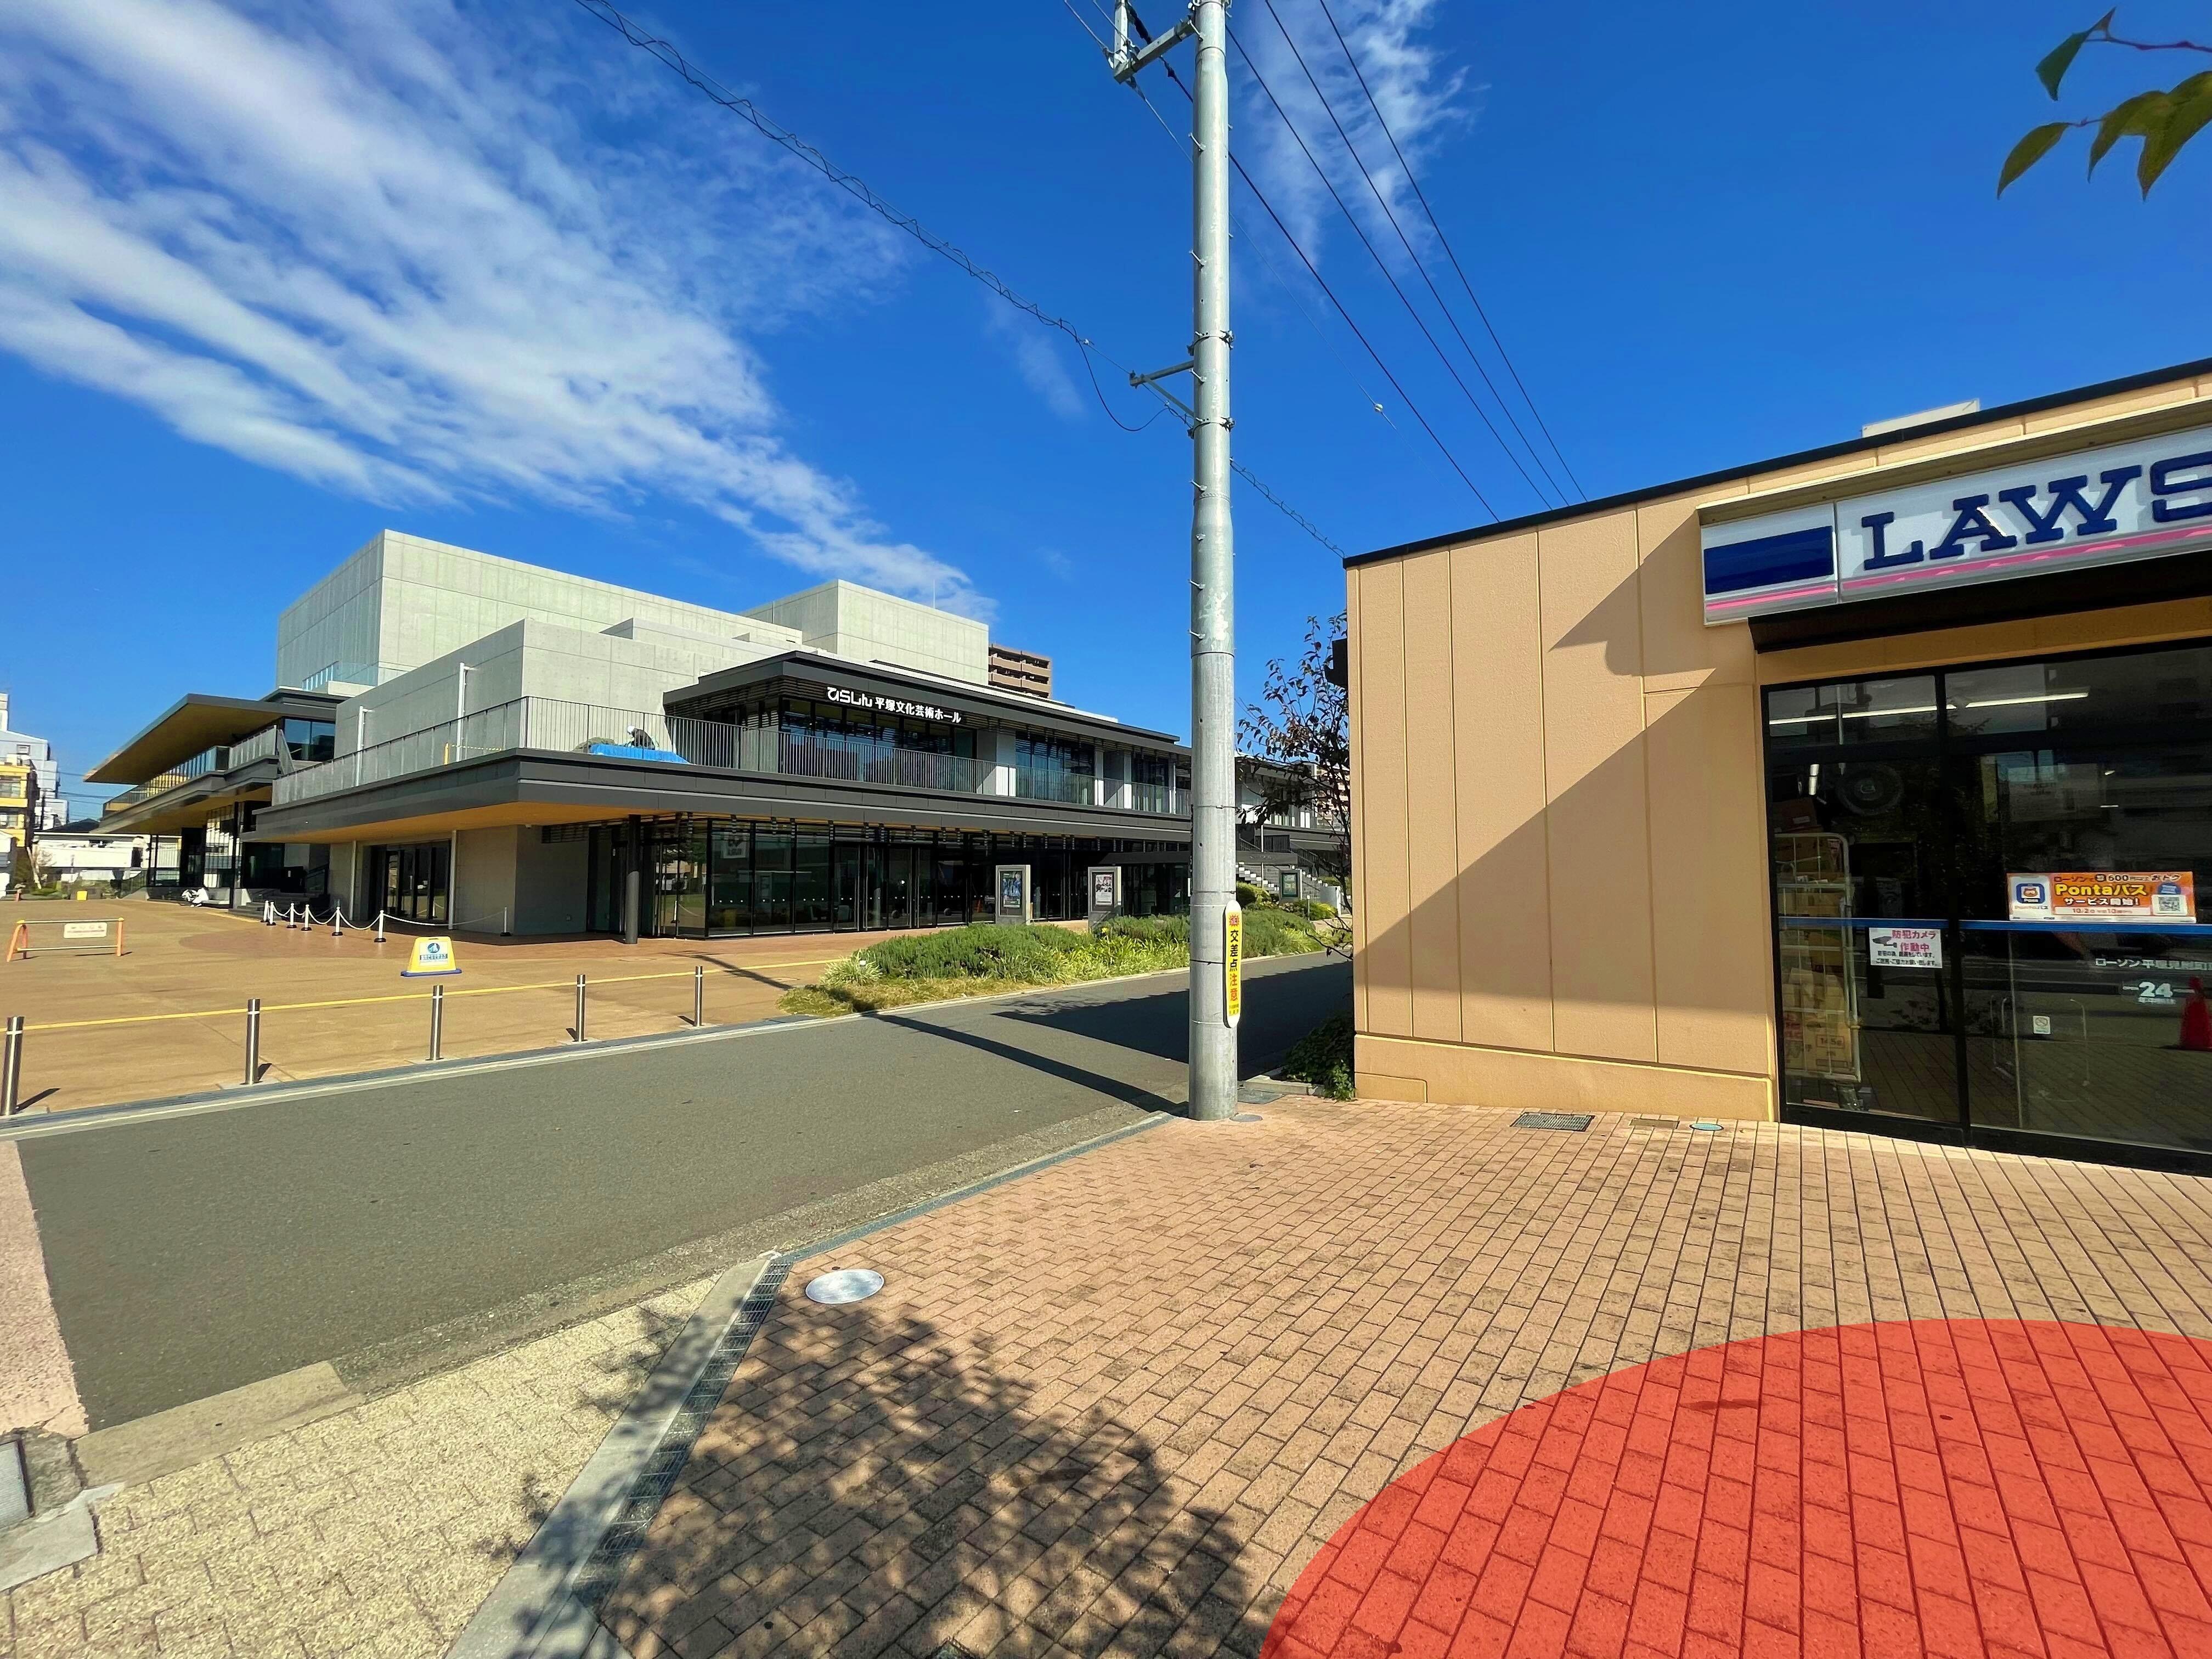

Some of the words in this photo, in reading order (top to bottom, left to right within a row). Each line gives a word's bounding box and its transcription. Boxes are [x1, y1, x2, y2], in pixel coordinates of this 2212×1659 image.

[1861, 452, 2212, 571] LAWS
[827, 686, 873, 708] ひらしん
[874, 696, 962, 723] 平塚文化芸術ホール
[2055, 883, 2147, 896] Pontaパス
[1892, 930, 1937, 939] 防犯カメラ
[1900, 942, 1930, 952] 作動中
[1229, 929, 1239, 1001] 交差点注意
[2138, 981, 2173, 998] 24
